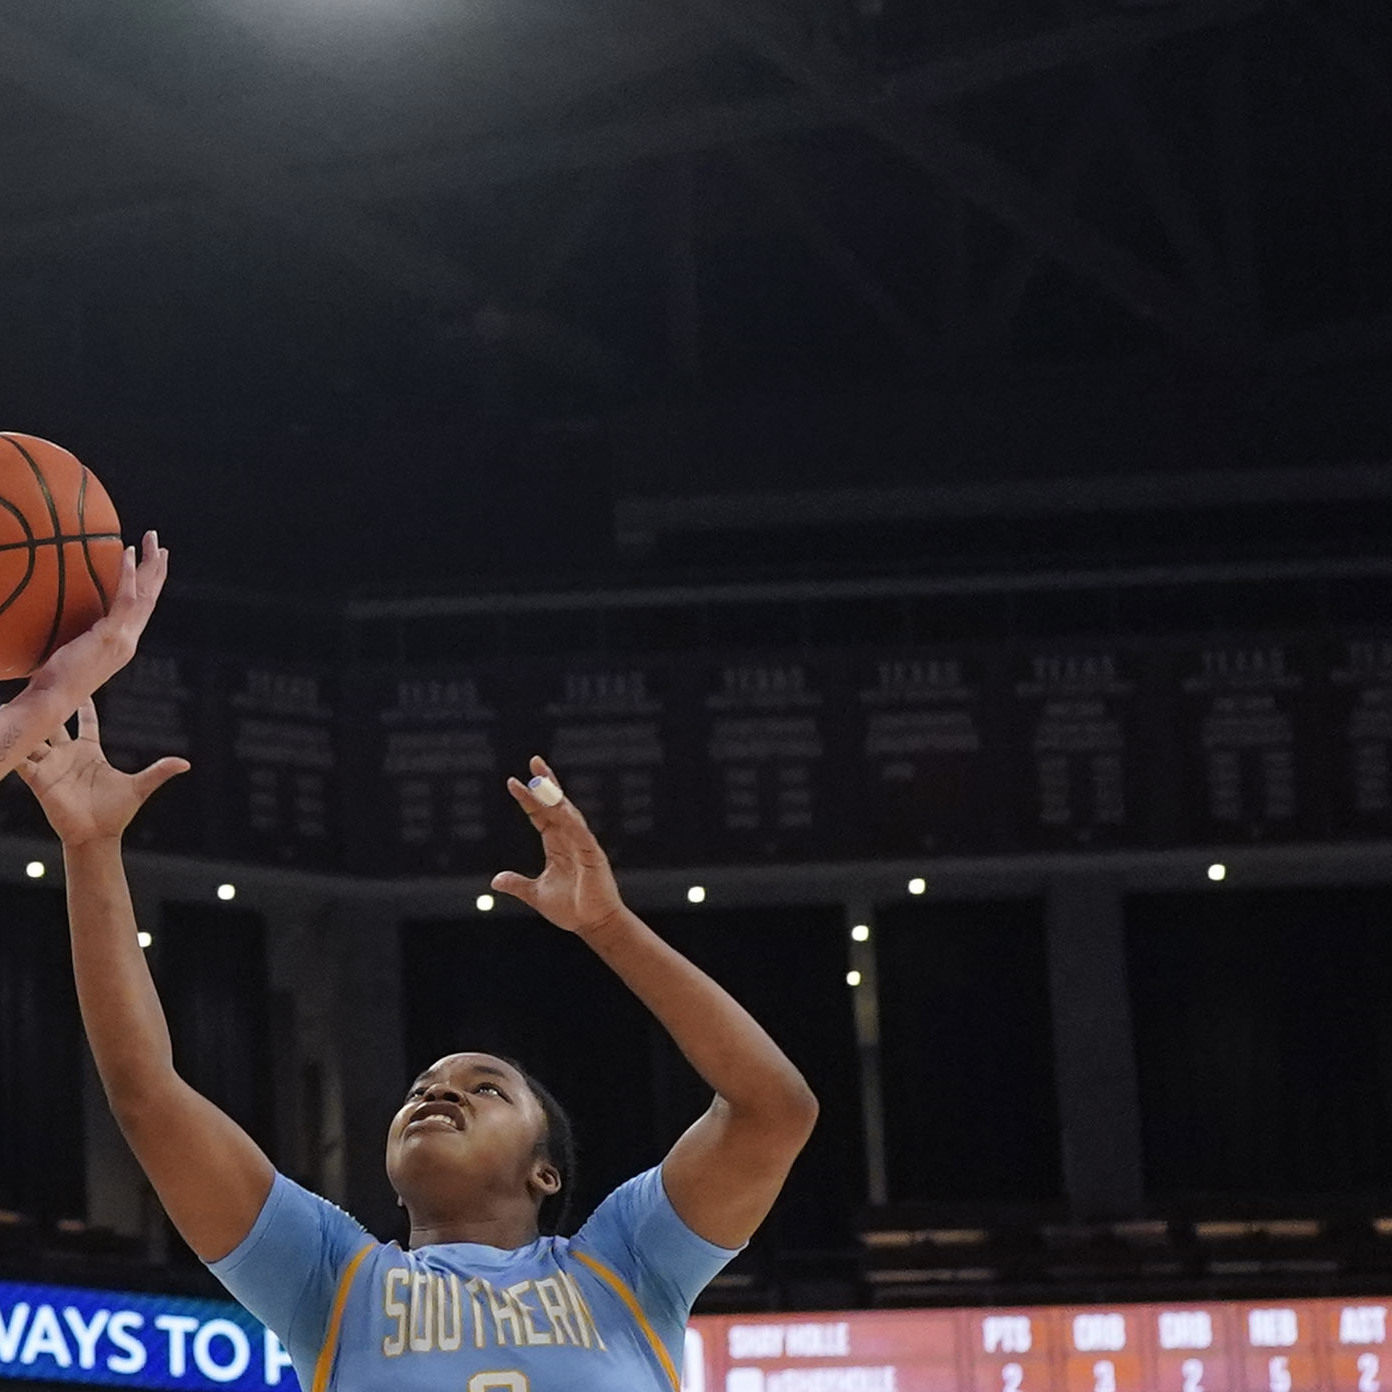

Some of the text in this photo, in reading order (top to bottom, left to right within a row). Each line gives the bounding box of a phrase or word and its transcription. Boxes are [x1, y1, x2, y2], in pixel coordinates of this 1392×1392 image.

[382, 1266, 608, 1358] SOUTHERN
[1339, 1306, 1387, 1345] AST
[155, 1313, 251, 1384] TO
[263, 1328, 293, 1387] P
